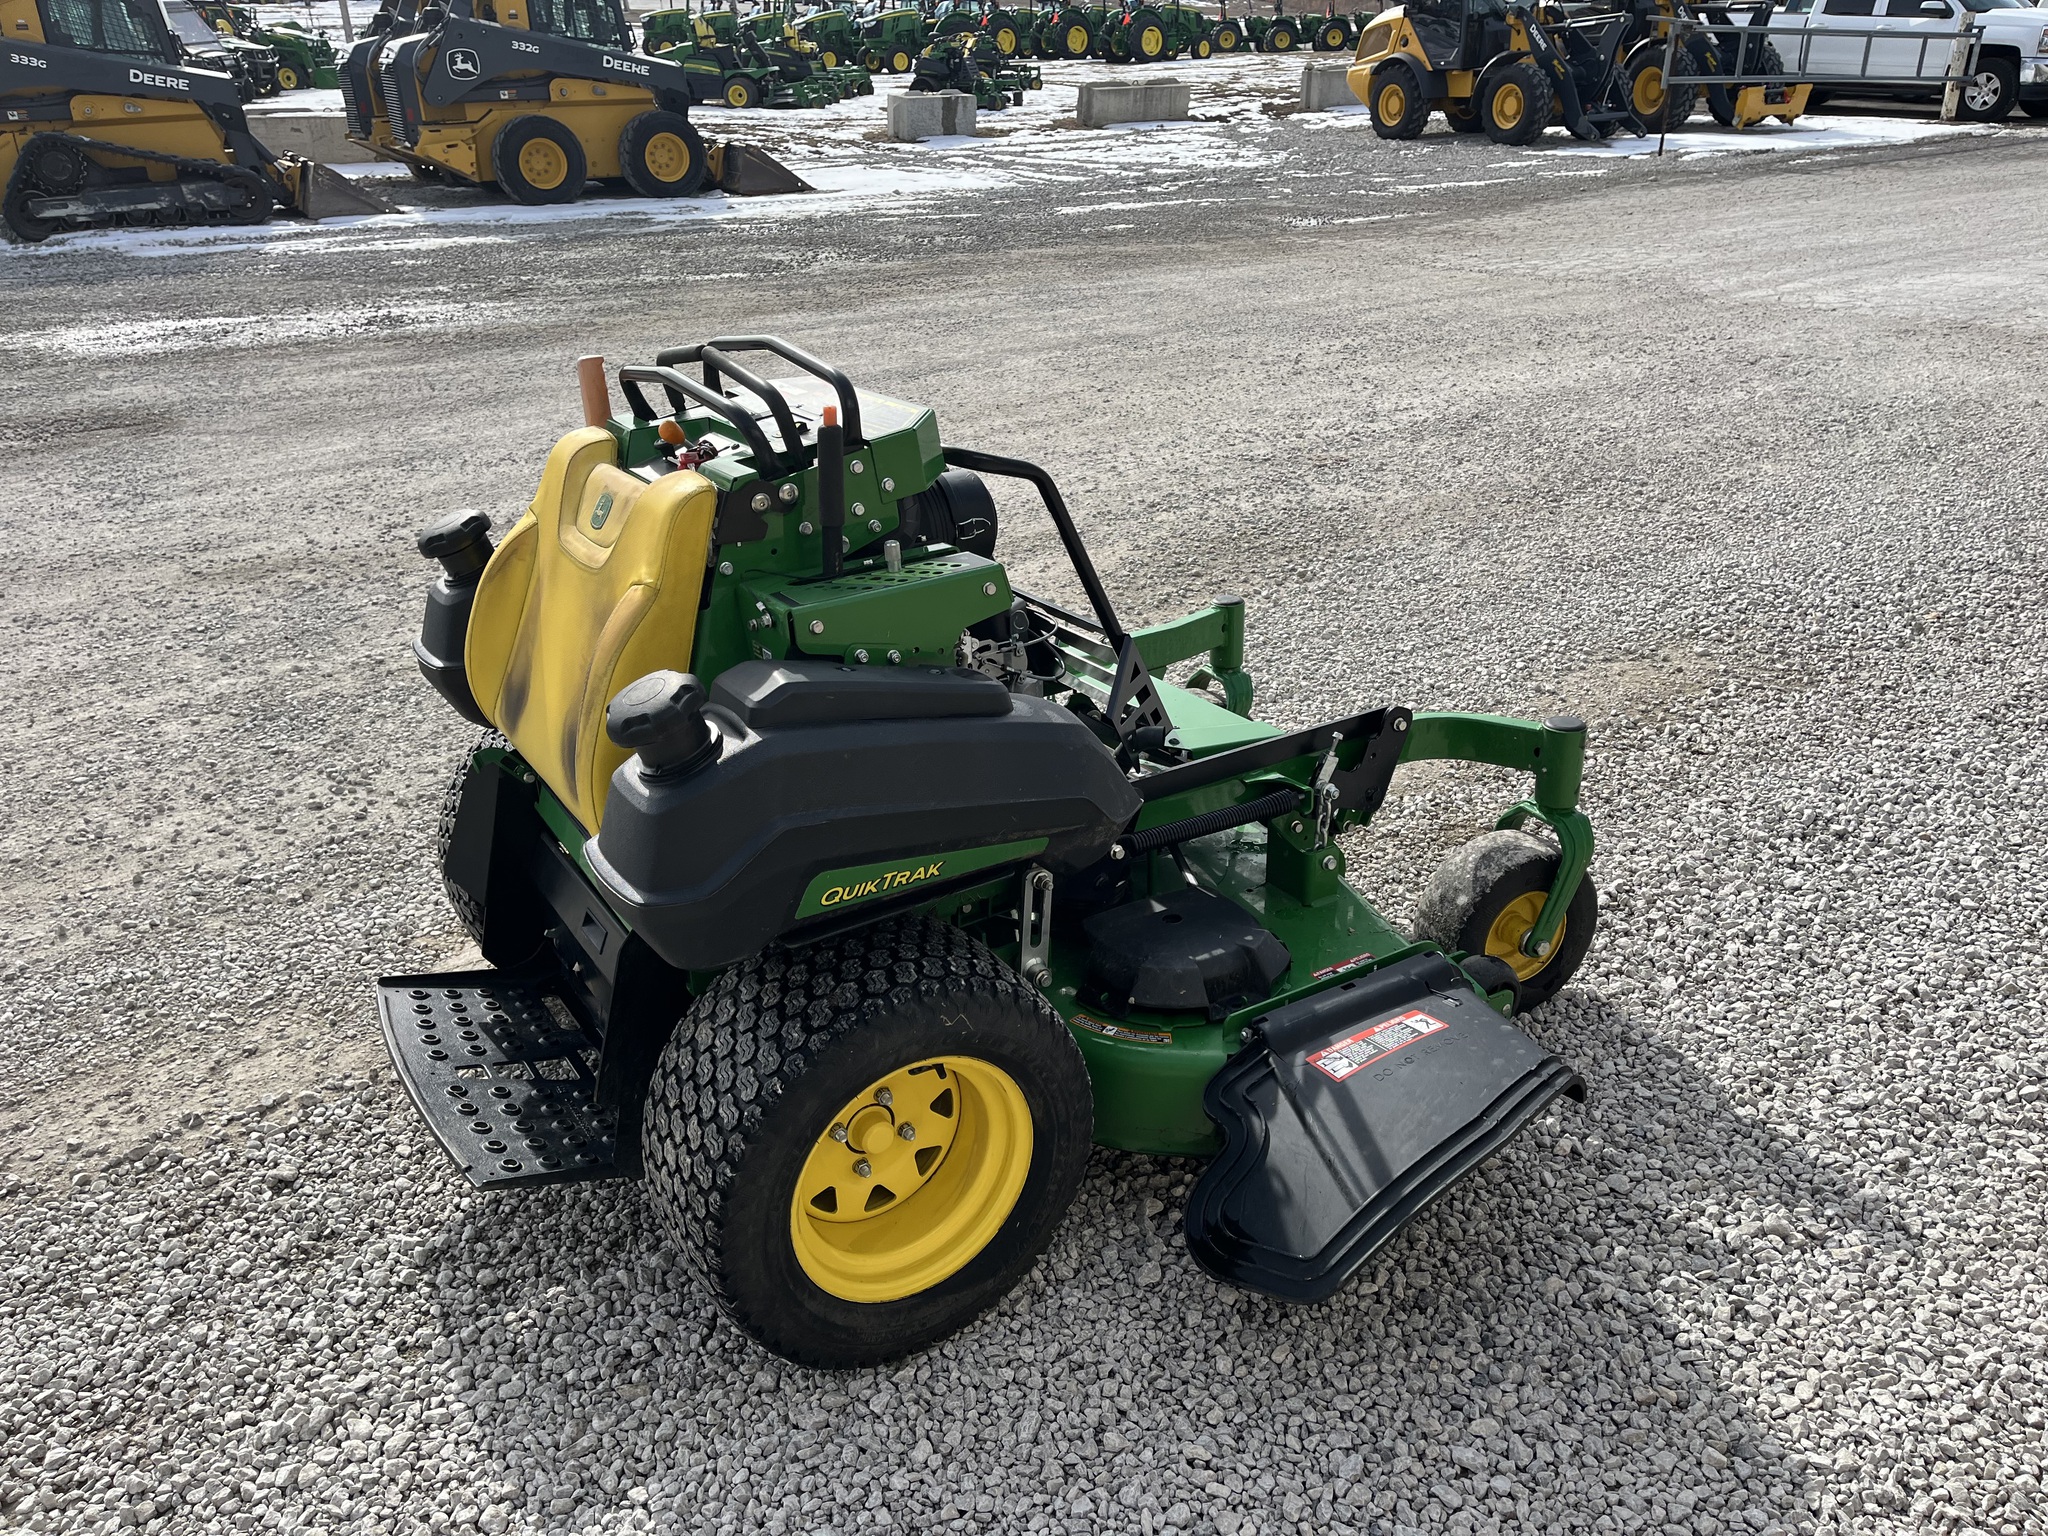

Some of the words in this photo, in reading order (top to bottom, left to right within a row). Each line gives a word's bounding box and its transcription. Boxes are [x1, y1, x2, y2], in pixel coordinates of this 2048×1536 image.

[511, 40, 540, 54] 332G
[1529, 23, 1548, 51] DEERE
[10, 53, 47, 69] 333G
[602, 55, 650, 76] DEERE
[129, 68, 190, 91] DEERE
[1373, 1068, 1394, 1082] DO
[1395, 1053, 1420, 1069] NOT
[1421, 1032, 1469, 1055] REMOVE
